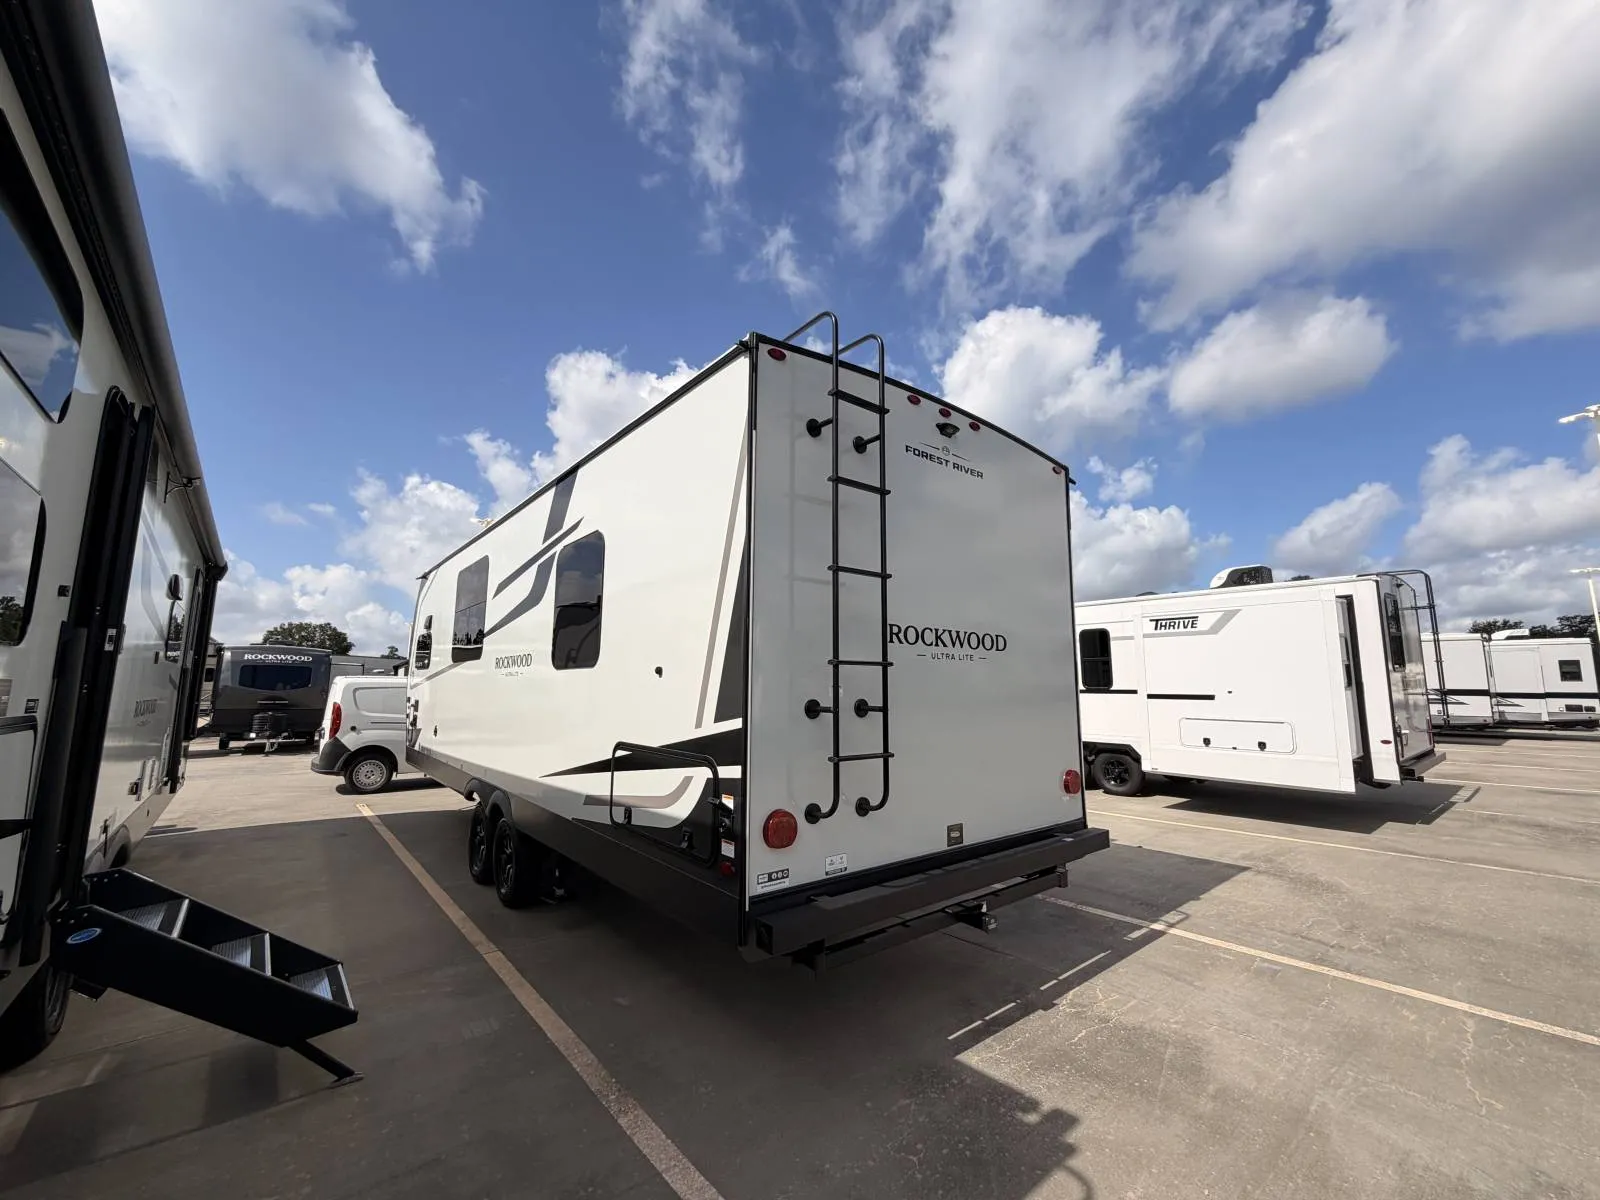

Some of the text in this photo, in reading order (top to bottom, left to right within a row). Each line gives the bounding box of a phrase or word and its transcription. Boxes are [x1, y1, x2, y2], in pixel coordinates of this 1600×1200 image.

[905, 445, 984, 479] FOREST RIVER
[1149, 616, 1199, 631] THRIVE
[888, 623, 1007, 652] ROCKWOOD
[243, 653, 313, 662] ROCKWOOD
[495, 653, 533, 670] ROCKWOOD
[931, 653, 974, 662] ULTRA LITE
